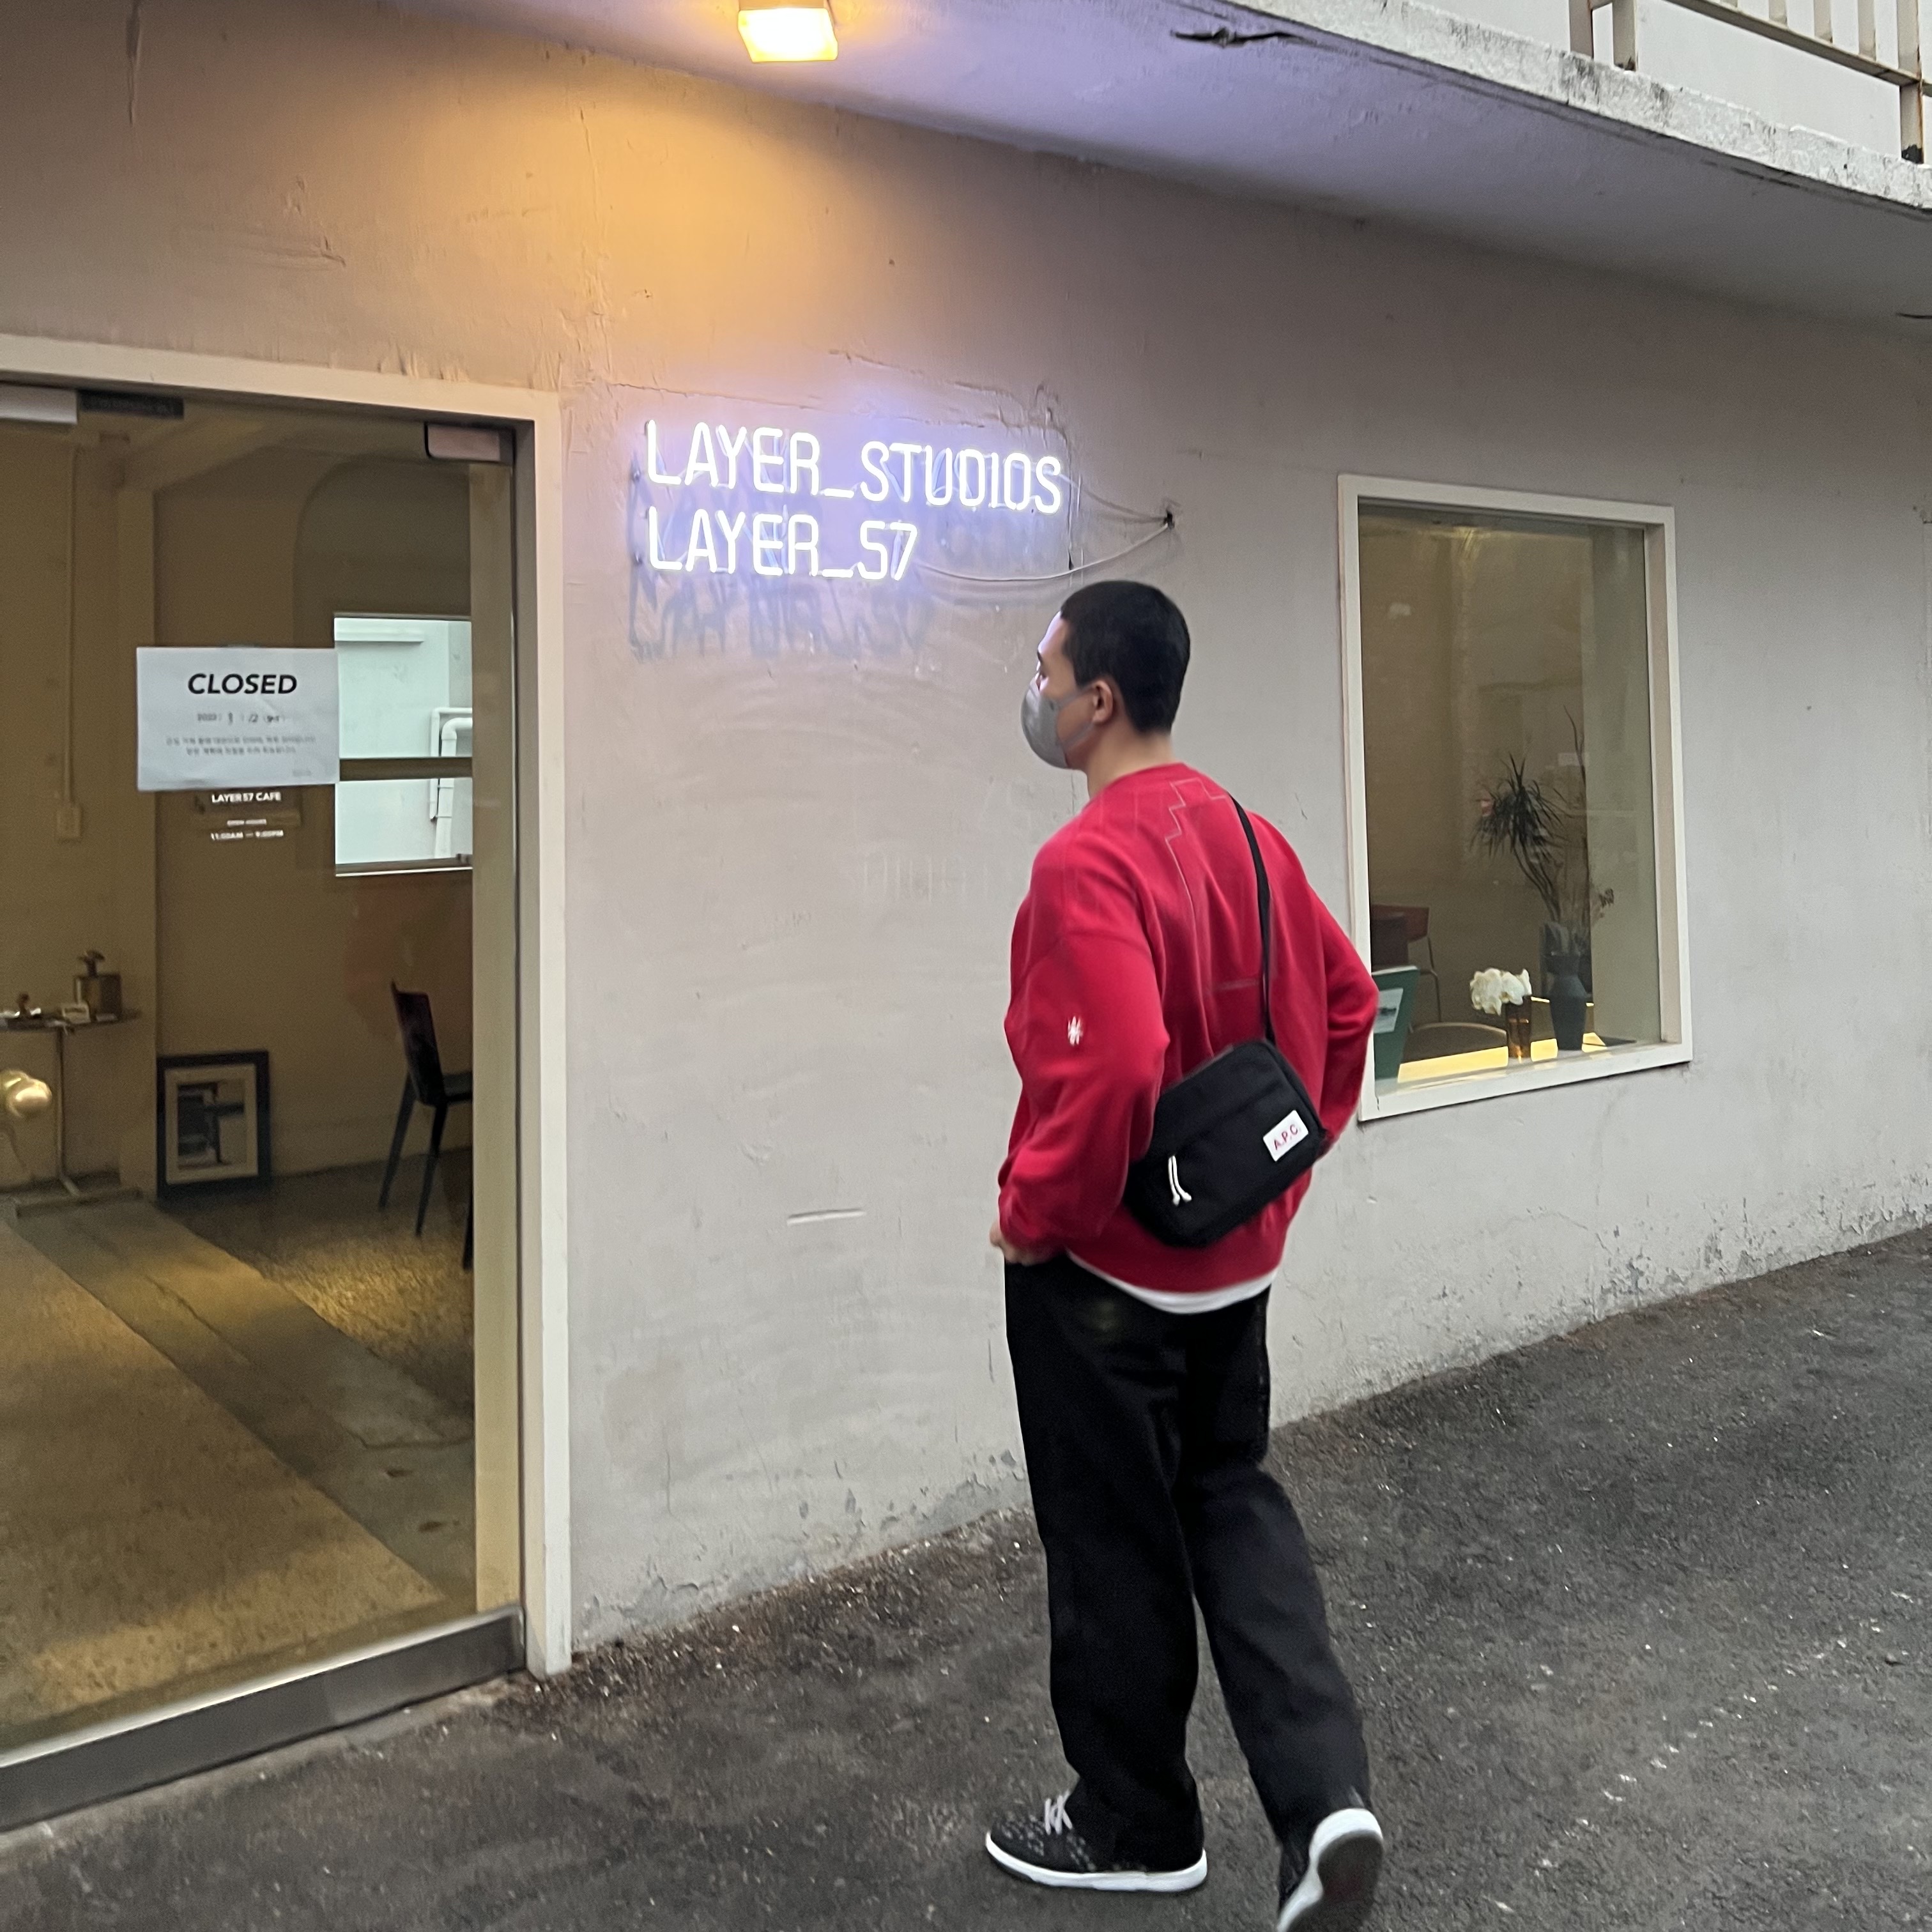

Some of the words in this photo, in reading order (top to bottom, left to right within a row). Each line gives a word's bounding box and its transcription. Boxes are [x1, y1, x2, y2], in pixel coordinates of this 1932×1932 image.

[647, 419, 1062, 514] LAYER_STUDIOS
[648, 505, 918, 581] LAYER_57
[188, 673, 298, 694] CLOSED
[256, 792, 281, 802] CAFE
